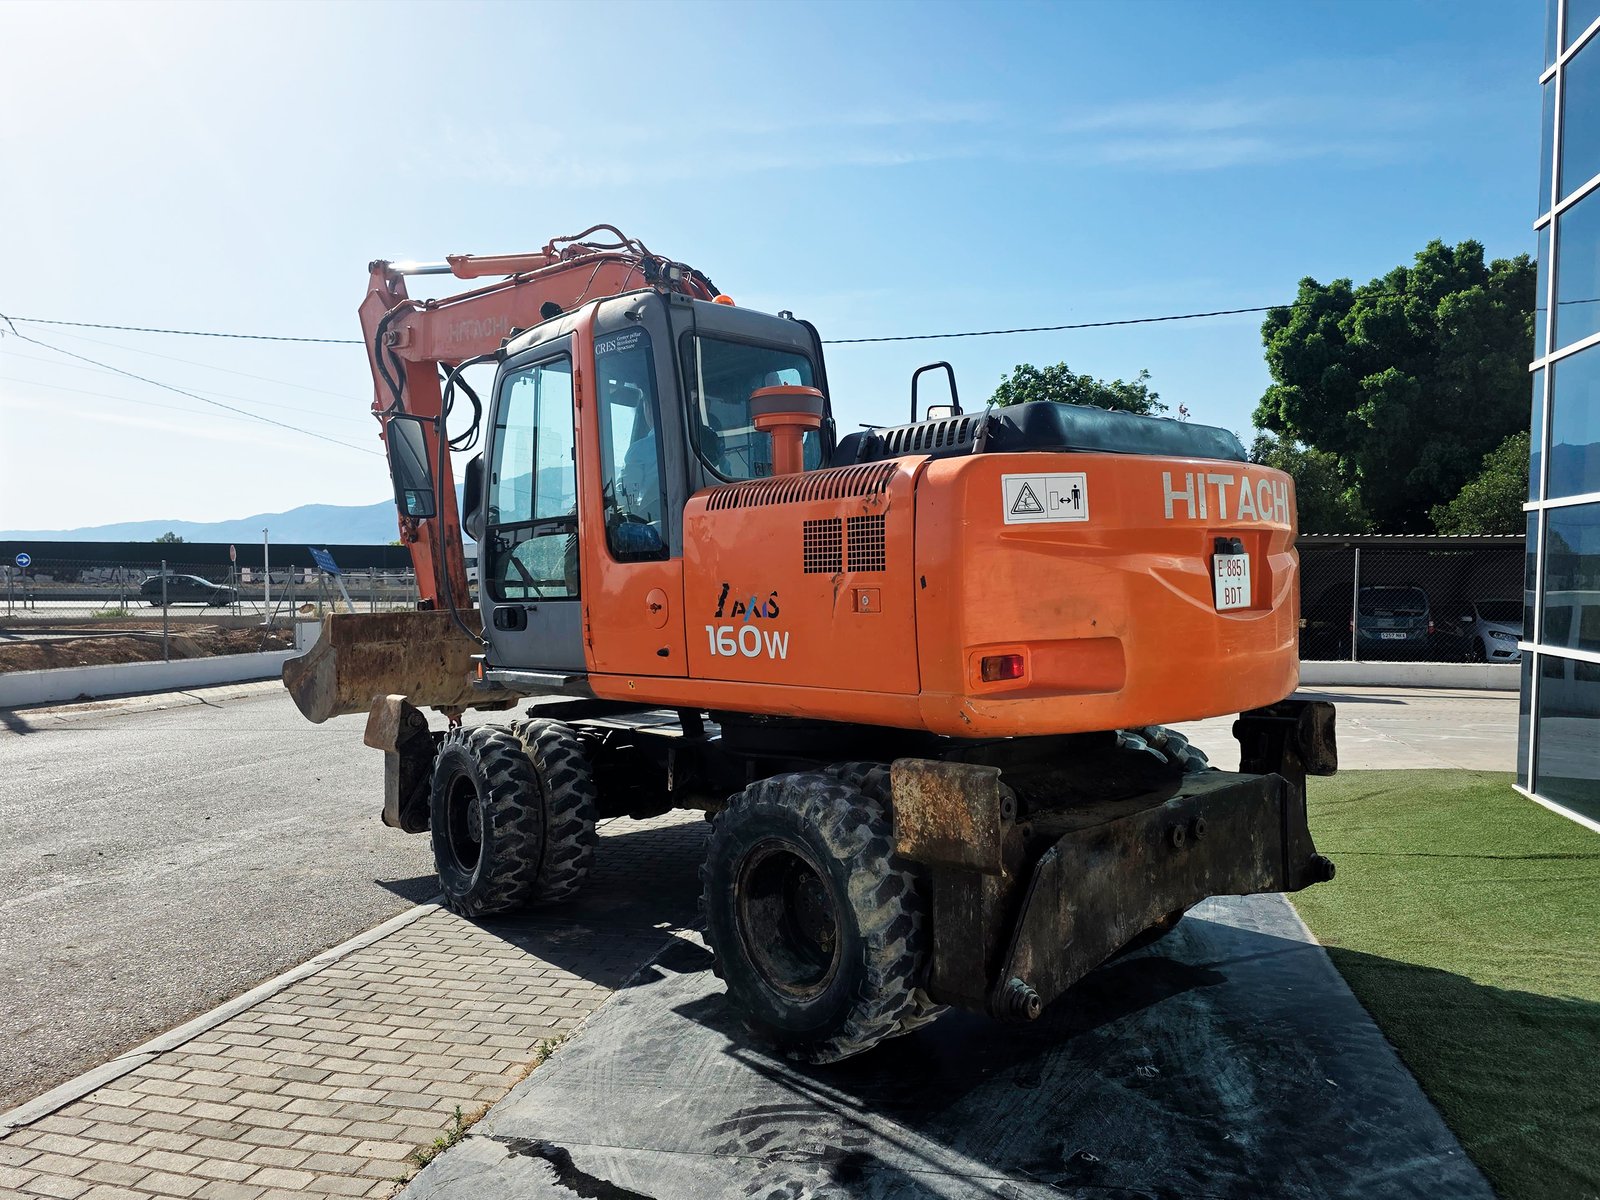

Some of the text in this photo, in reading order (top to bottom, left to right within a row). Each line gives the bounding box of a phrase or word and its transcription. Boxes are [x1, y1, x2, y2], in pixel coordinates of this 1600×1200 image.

[595, 340, 616, 355] CRES
[1162, 471, 1290, 524] HITACHI
[1218, 559, 1246, 577] E 8851
[1225, 586, 1242, 605] BDT
[705, 624, 790, 660] 160W
